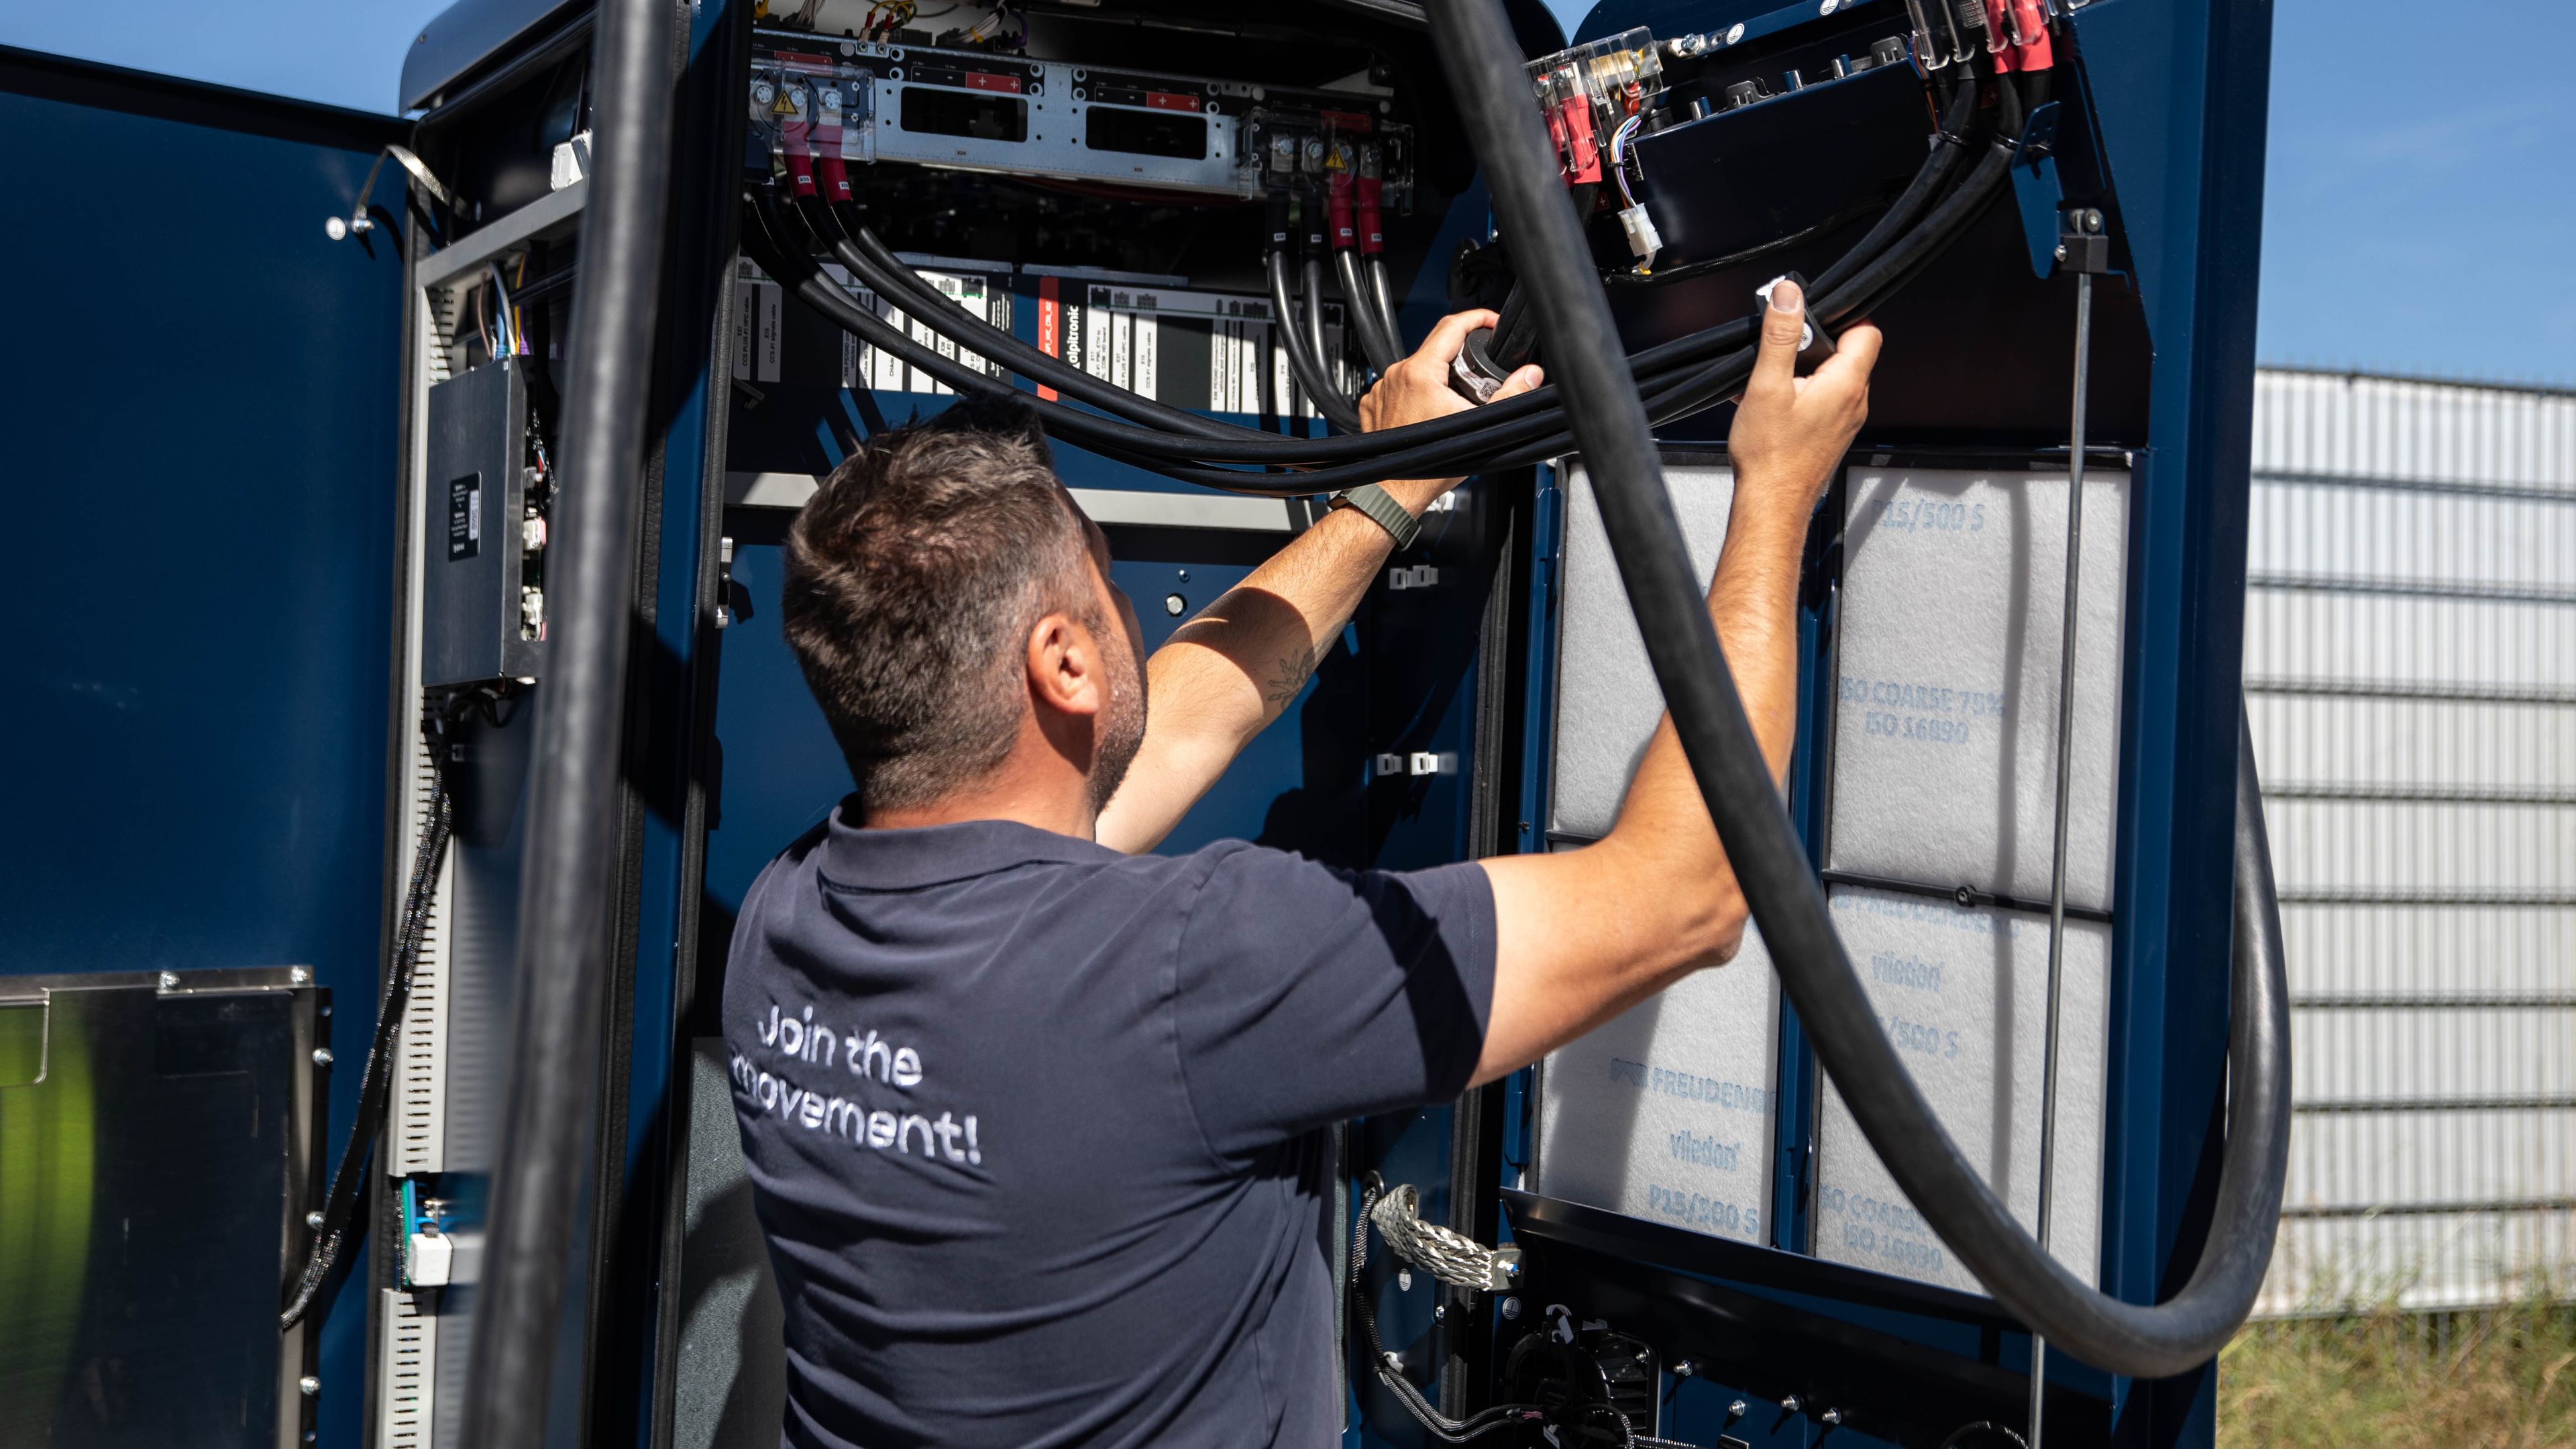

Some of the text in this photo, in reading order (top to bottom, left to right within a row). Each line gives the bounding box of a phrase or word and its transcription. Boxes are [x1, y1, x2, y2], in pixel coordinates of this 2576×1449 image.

[1067, 305, 1081, 364] alpitronic
[1970, 503, 1984, 532] S
[1874, 682, 1953, 712] COARSE
[1865, 710, 1970, 745] ISO 16890
[757, 1005, 923, 1086] Join the
[1943, 1030, 1960, 1061] S
[732, 1053, 981, 1166] movement!
[1649, 1183, 1760, 1236] P15/500 S
[1843, 1224, 1876, 1254] ISO
